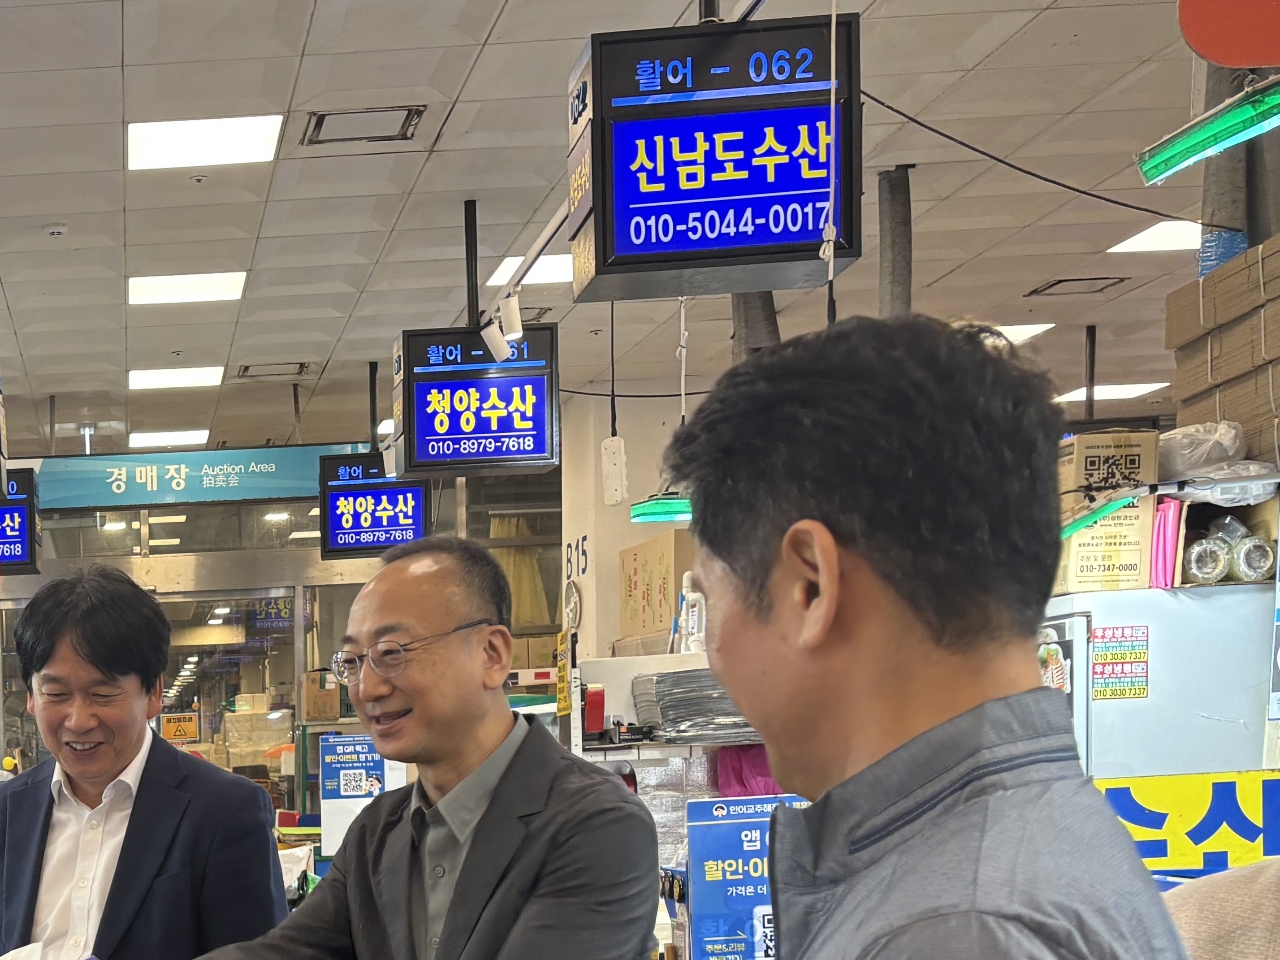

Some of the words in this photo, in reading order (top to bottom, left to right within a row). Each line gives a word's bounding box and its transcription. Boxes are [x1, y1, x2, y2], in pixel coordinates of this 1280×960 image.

[635, 57, 693, 91] 활어
[749, 47, 814, 83] 062
[630, 121, 834, 193] 신남도수산
[630, 201, 831, 244] 010-5044-0017
[427, 344, 462, 364] 활어
[426, 385, 536, 433] 청양수산
[428, 436, 534, 455] 010-8979-7618
[201, 463, 245, 475] Auction
[248, 462, 276, 473] Area
[338, 465, 363, 480] 활어
[202, 474, 239, 488] 拍卖会
[336, 493, 415, 528] 청양수산
[337, 529, 413, 544] 010-8979-7618
[1094, 653, 1107, 661] 010
[1110, 652, 1127, 660] 3030
[1129, 651, 1146, 660] 7337
[1094, 689, 1107, 697] 010
[1109, 688, 1126, 697] 3030
[1127, 687, 1146, 696] 7337
[741, 829, 761, 851] 앱
[704, 857, 769, 881] 할인·이
[727, 885, 755, 897] 가격은
[757, 884, 767, 894] 더
